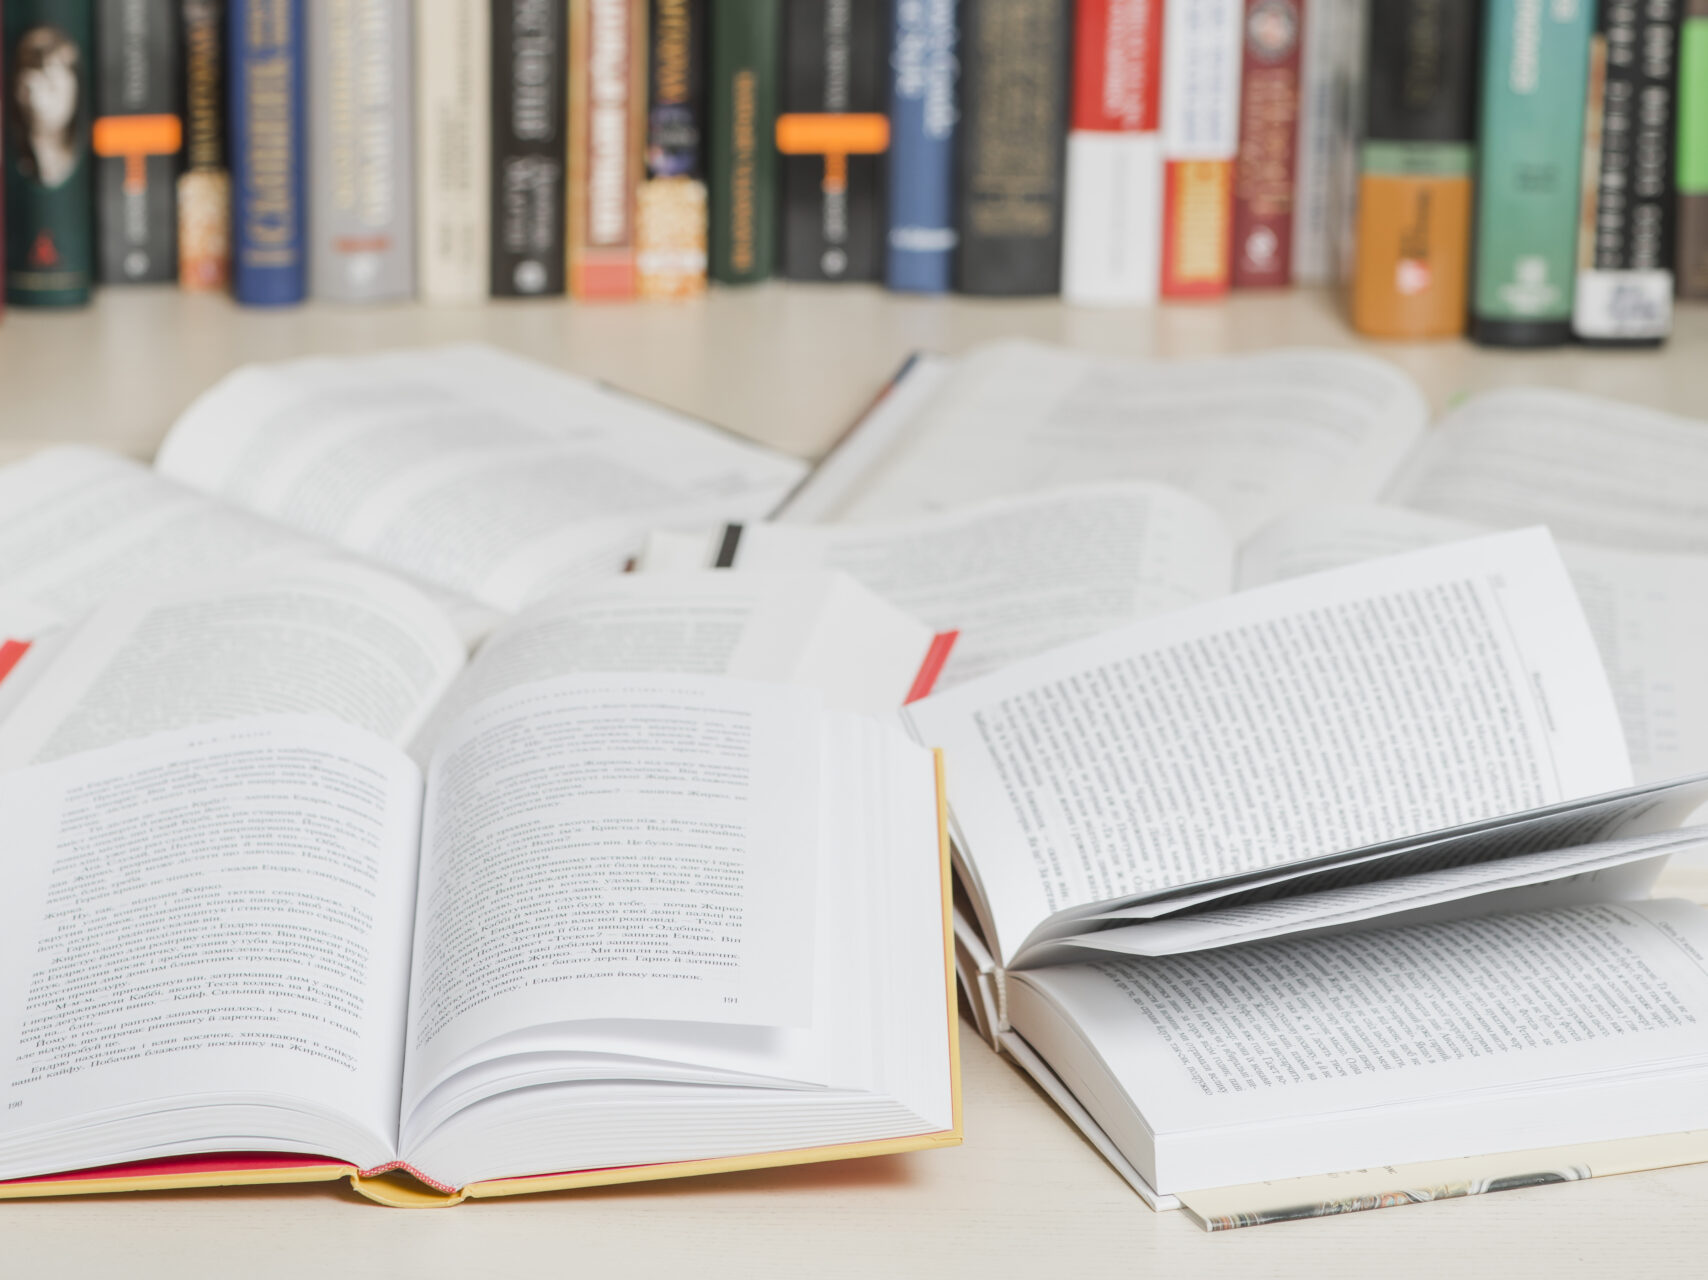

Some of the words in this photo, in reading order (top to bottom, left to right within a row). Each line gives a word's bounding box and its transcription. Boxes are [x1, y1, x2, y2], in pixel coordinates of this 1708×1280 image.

[702, 903, 743, 912] Жирко
[530, 946, 550, 954] такі
[555, 940, 602, 950] дебільні
[674, 933, 716, 942] Ендрю.
[722, 936, 741, 944] Він
[466, 960, 524, 986] підтвердив
[529, 951, 572, 962] Жирко.
[672, 949, 738, 959] майданчик.
[482, 963, 538, 986] туалетами
[552, 957, 591, 966] багато
[635, 955, 672, 963] Гарно
[686, 958, 740, 968] затишно.
[30, 999, 124, 1026] передражнюючи
[168, 984, 201, 994] якого
[307, 985, 344, 1002] Різдво
[112, 979, 182, 997] причмокнув
[425, 1017, 453, 1042] Жирко
[454, 996, 490, 1016] змінив
[493, 985, 522, 998] позу,
[532, 975, 572, 984] Ендрю
[576, 971, 614, 979] віддав
[618, 970, 648, 979] йому
[652, 972, 704, 981] косячок.
[22, 1024, 52, 1035] вчала
[56, 1007, 123, 1026] дегустувати
[174, 990, 206, 1000] Кайф.
[269, 990, 320, 1004] присмак.
[36, 1036, 66, 1048] Йому
[82, 1024, 116, 1036] голові
[120, 1016, 162, 1030] раптом
[164, 1006, 265, 1019] запаморочилось,
[302, 1012, 318, 1020] він
[16, 1052, 35, 1062] але
[38, 1042, 77, 1056] відчув,
[81, 1037, 98, 1046] що
[100, 1028, 142, 1040] втрачає
[148, 1018, 204, 1032] рівновагу
[20, 1034, 40, 1044] ком
[31, 1060, 70, 1074] Ендрю
[76, 1046, 136, 1062] нахилився
[151, 1038, 177, 1047] взяв
[183, 1033, 234, 1042] косячок,
[240, 1032, 307, 1044] хихикаючи
[12, 1074, 42, 1086] ванні
[46, 1066, 86, 1078] кайфу.
[91, 1053, 140, 1067] Побачив
[144, 1044, 202, 1056] блаженну
[290, 1044, 358, 1072] Жирковому
[8, 1100, 23, 1110] 190
